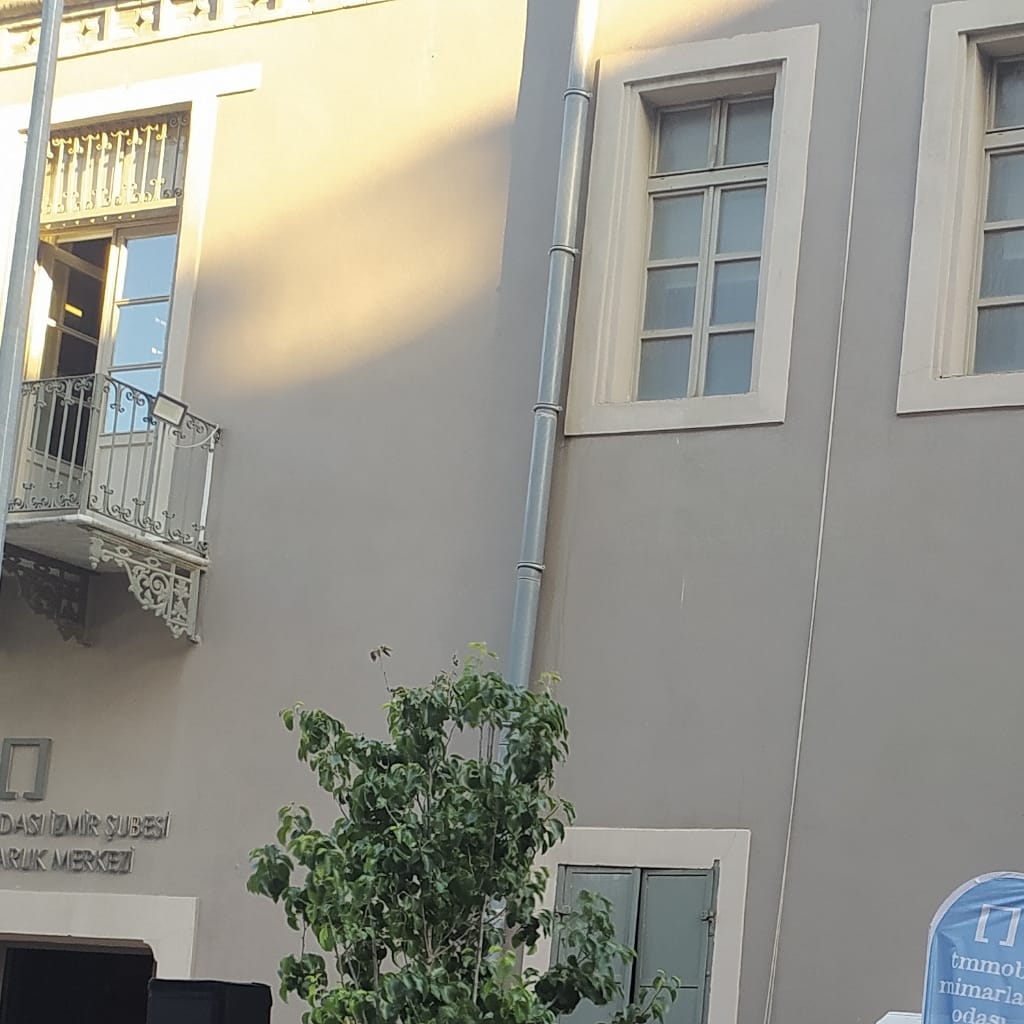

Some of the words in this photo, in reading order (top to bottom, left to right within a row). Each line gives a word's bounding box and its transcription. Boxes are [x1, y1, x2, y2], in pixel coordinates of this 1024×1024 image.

[50, 808, 101, 837] İZMİR
[105, 811, 172, 842] ŞUBESİ
[51, 846, 136, 874] MERKEZİ
